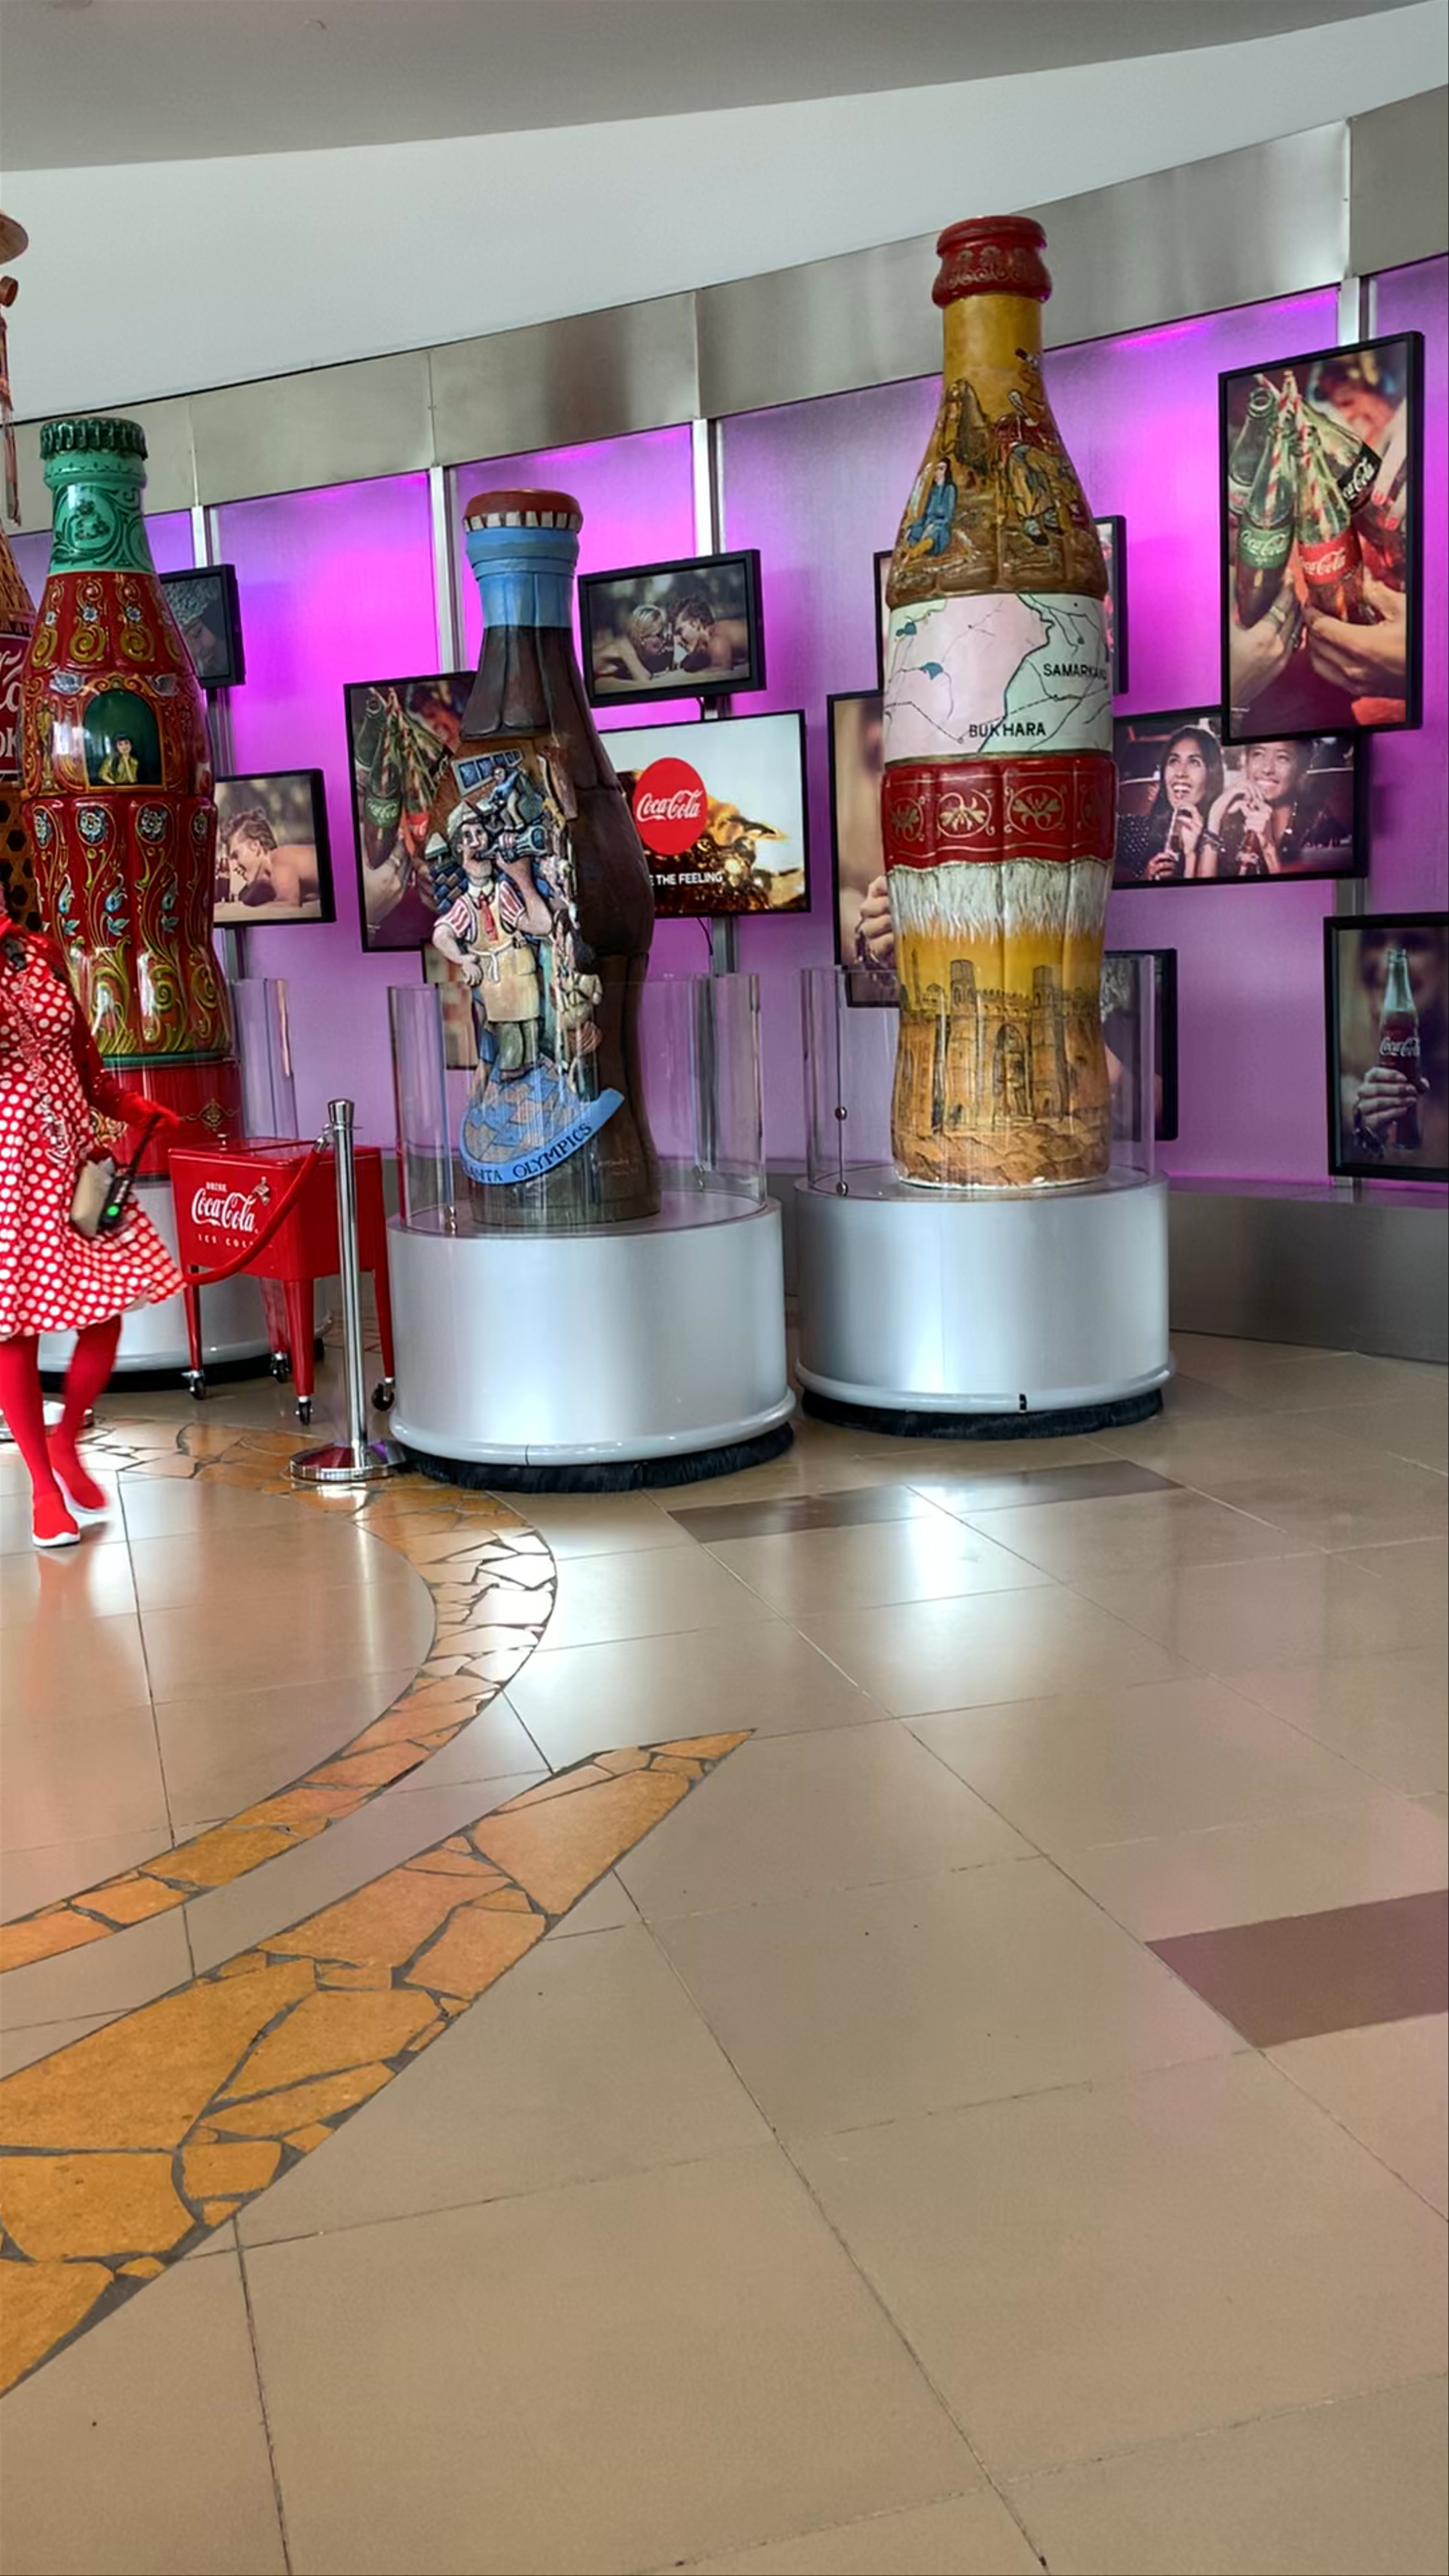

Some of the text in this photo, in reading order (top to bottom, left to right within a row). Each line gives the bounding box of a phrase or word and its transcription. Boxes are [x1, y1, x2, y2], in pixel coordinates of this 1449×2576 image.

[637, 789, 703, 822] Coca-Cola
[655, 874, 677, 885] THE
[678, 872, 723, 884] FEELING
[513, 1123, 592, 1178] OLYMPICS
[192, 1188, 256, 1232] Coca-Cola
